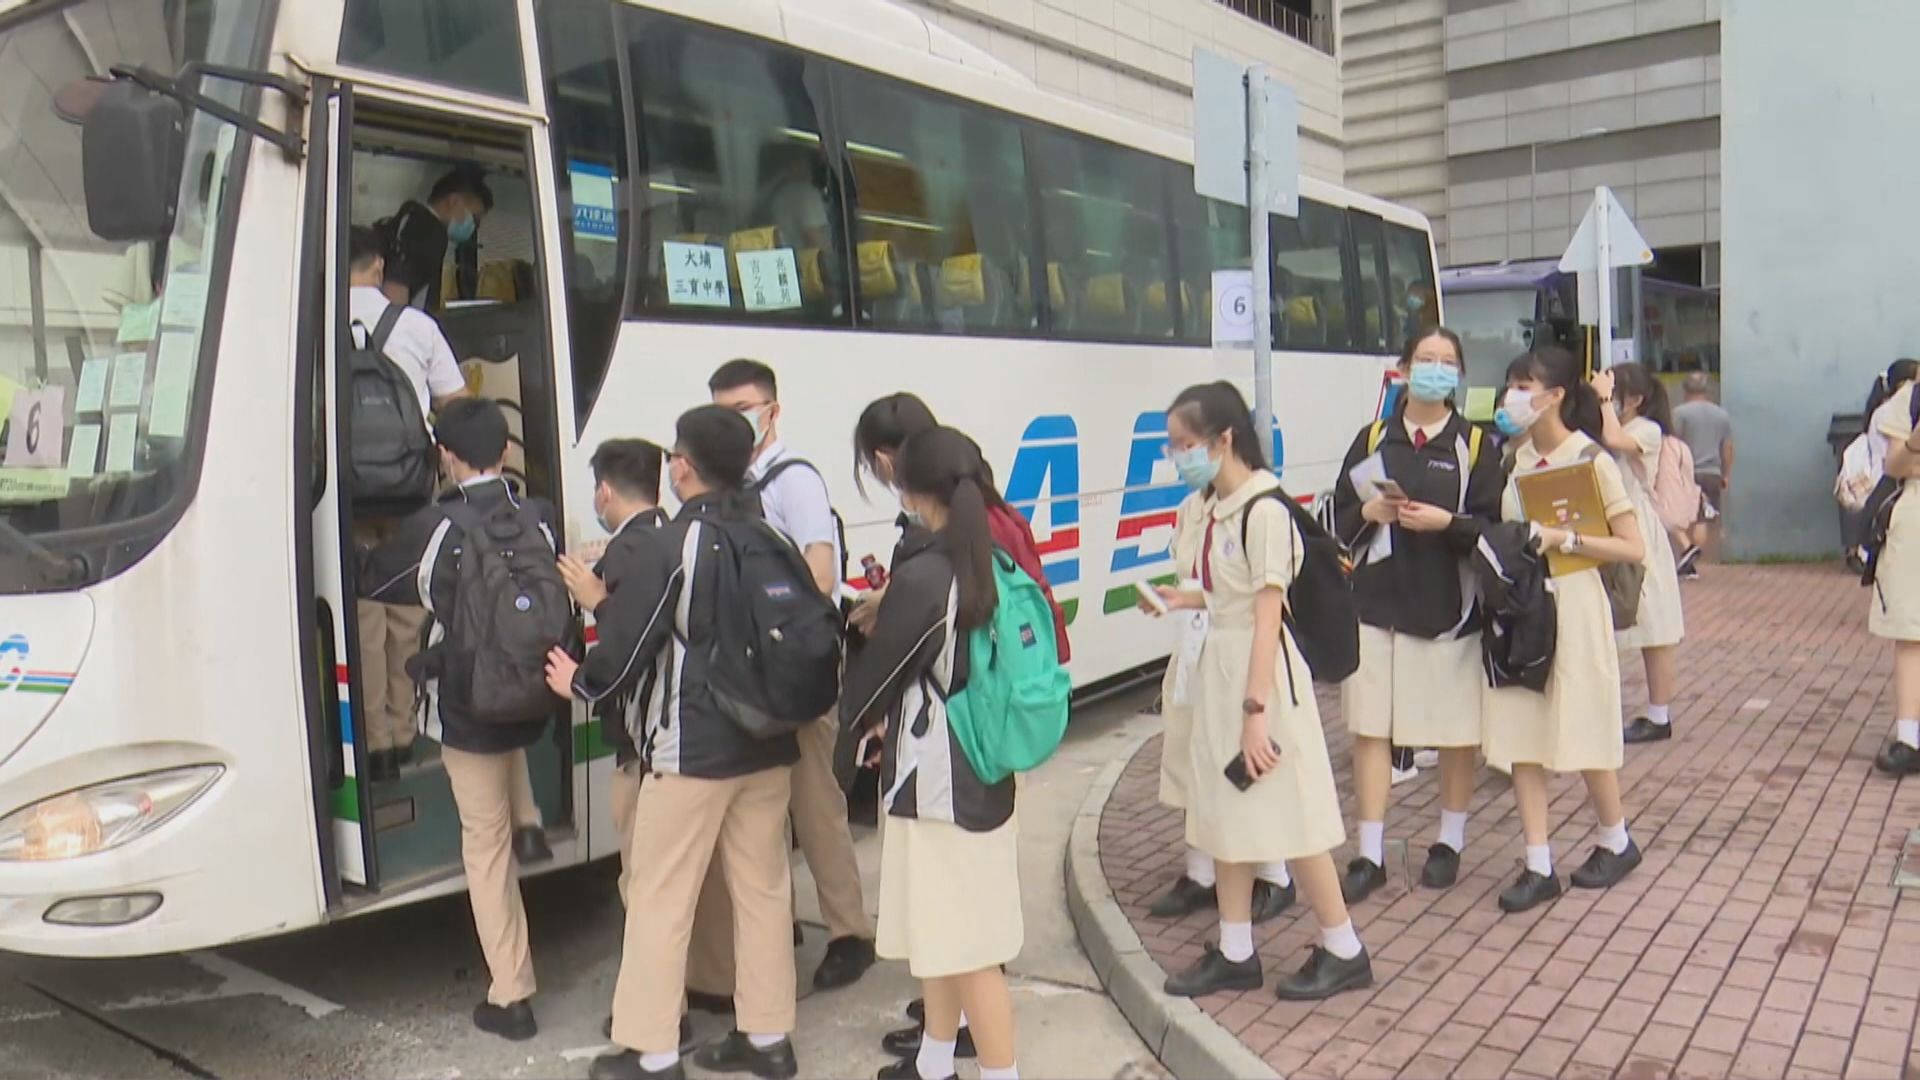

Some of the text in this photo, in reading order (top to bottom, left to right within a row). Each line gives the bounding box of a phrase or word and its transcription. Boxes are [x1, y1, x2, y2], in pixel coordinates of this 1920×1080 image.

[684, 248, 712, 270] 大埔
[674, 278, 725, 298] 三育中學
[1234, 297, 1246, 315] 6
[26, 401, 41, 455] 6
